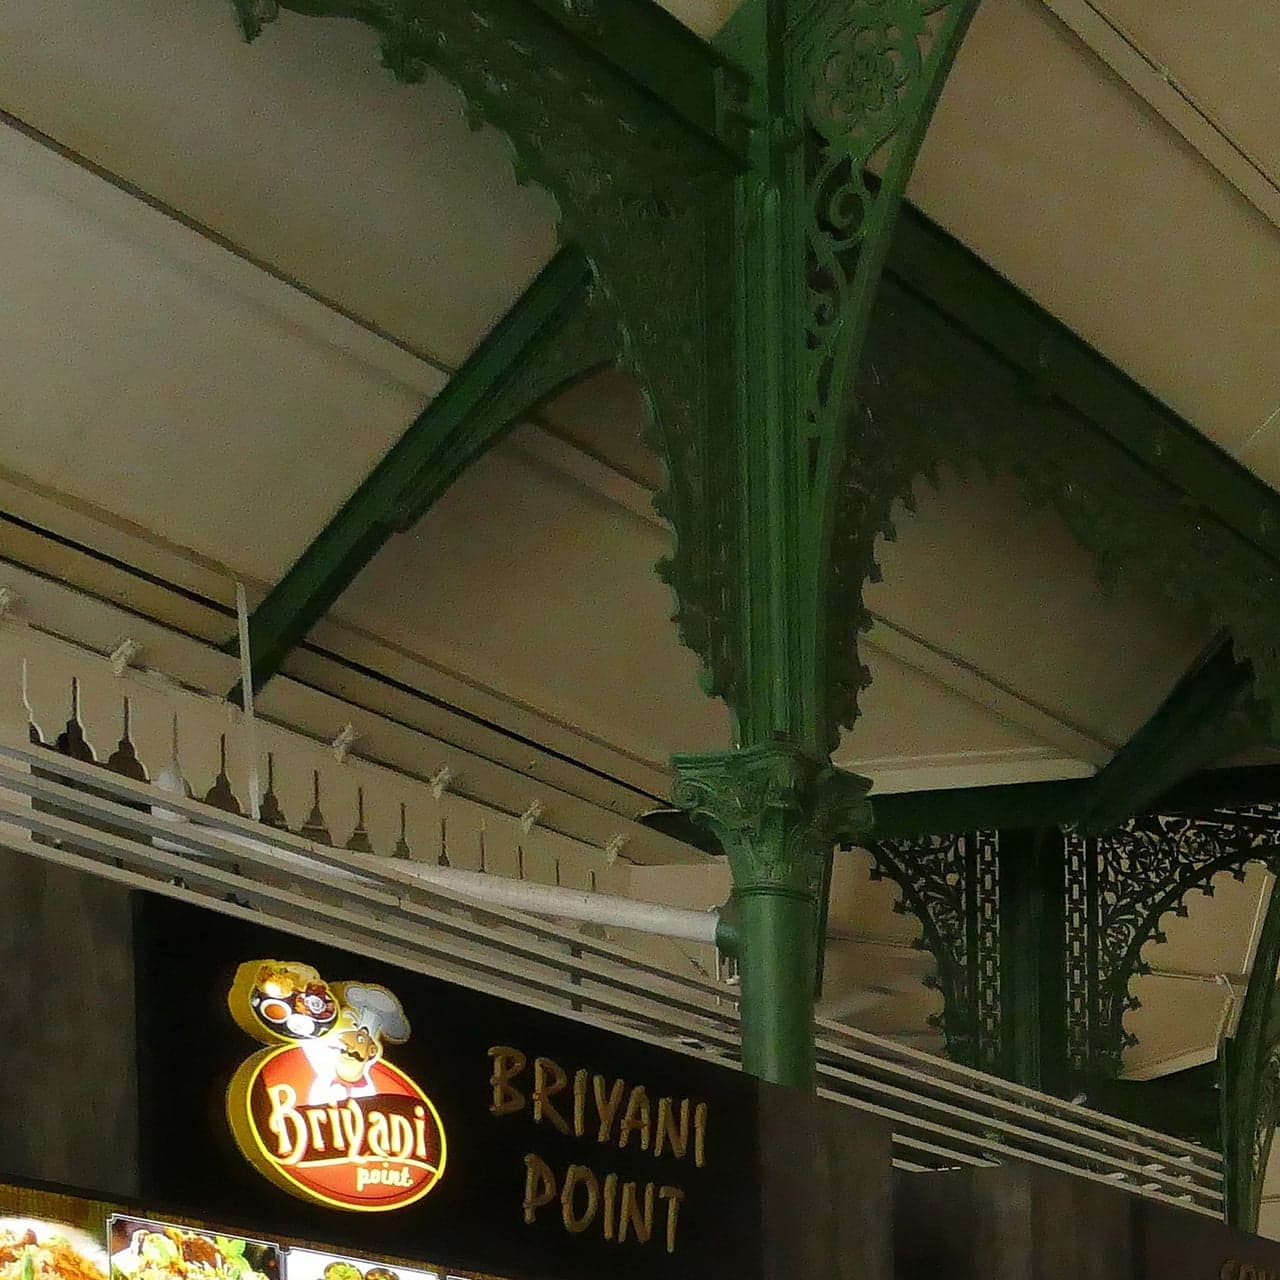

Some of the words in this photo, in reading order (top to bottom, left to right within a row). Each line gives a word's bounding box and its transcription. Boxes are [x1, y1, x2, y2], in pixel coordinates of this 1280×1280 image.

[269, 1083, 427, 1165] Briyani
[488, 1046, 707, 1167] BRIYANI
[356, 1162, 413, 1191] point
[523, 1153, 685, 1253] POINT
